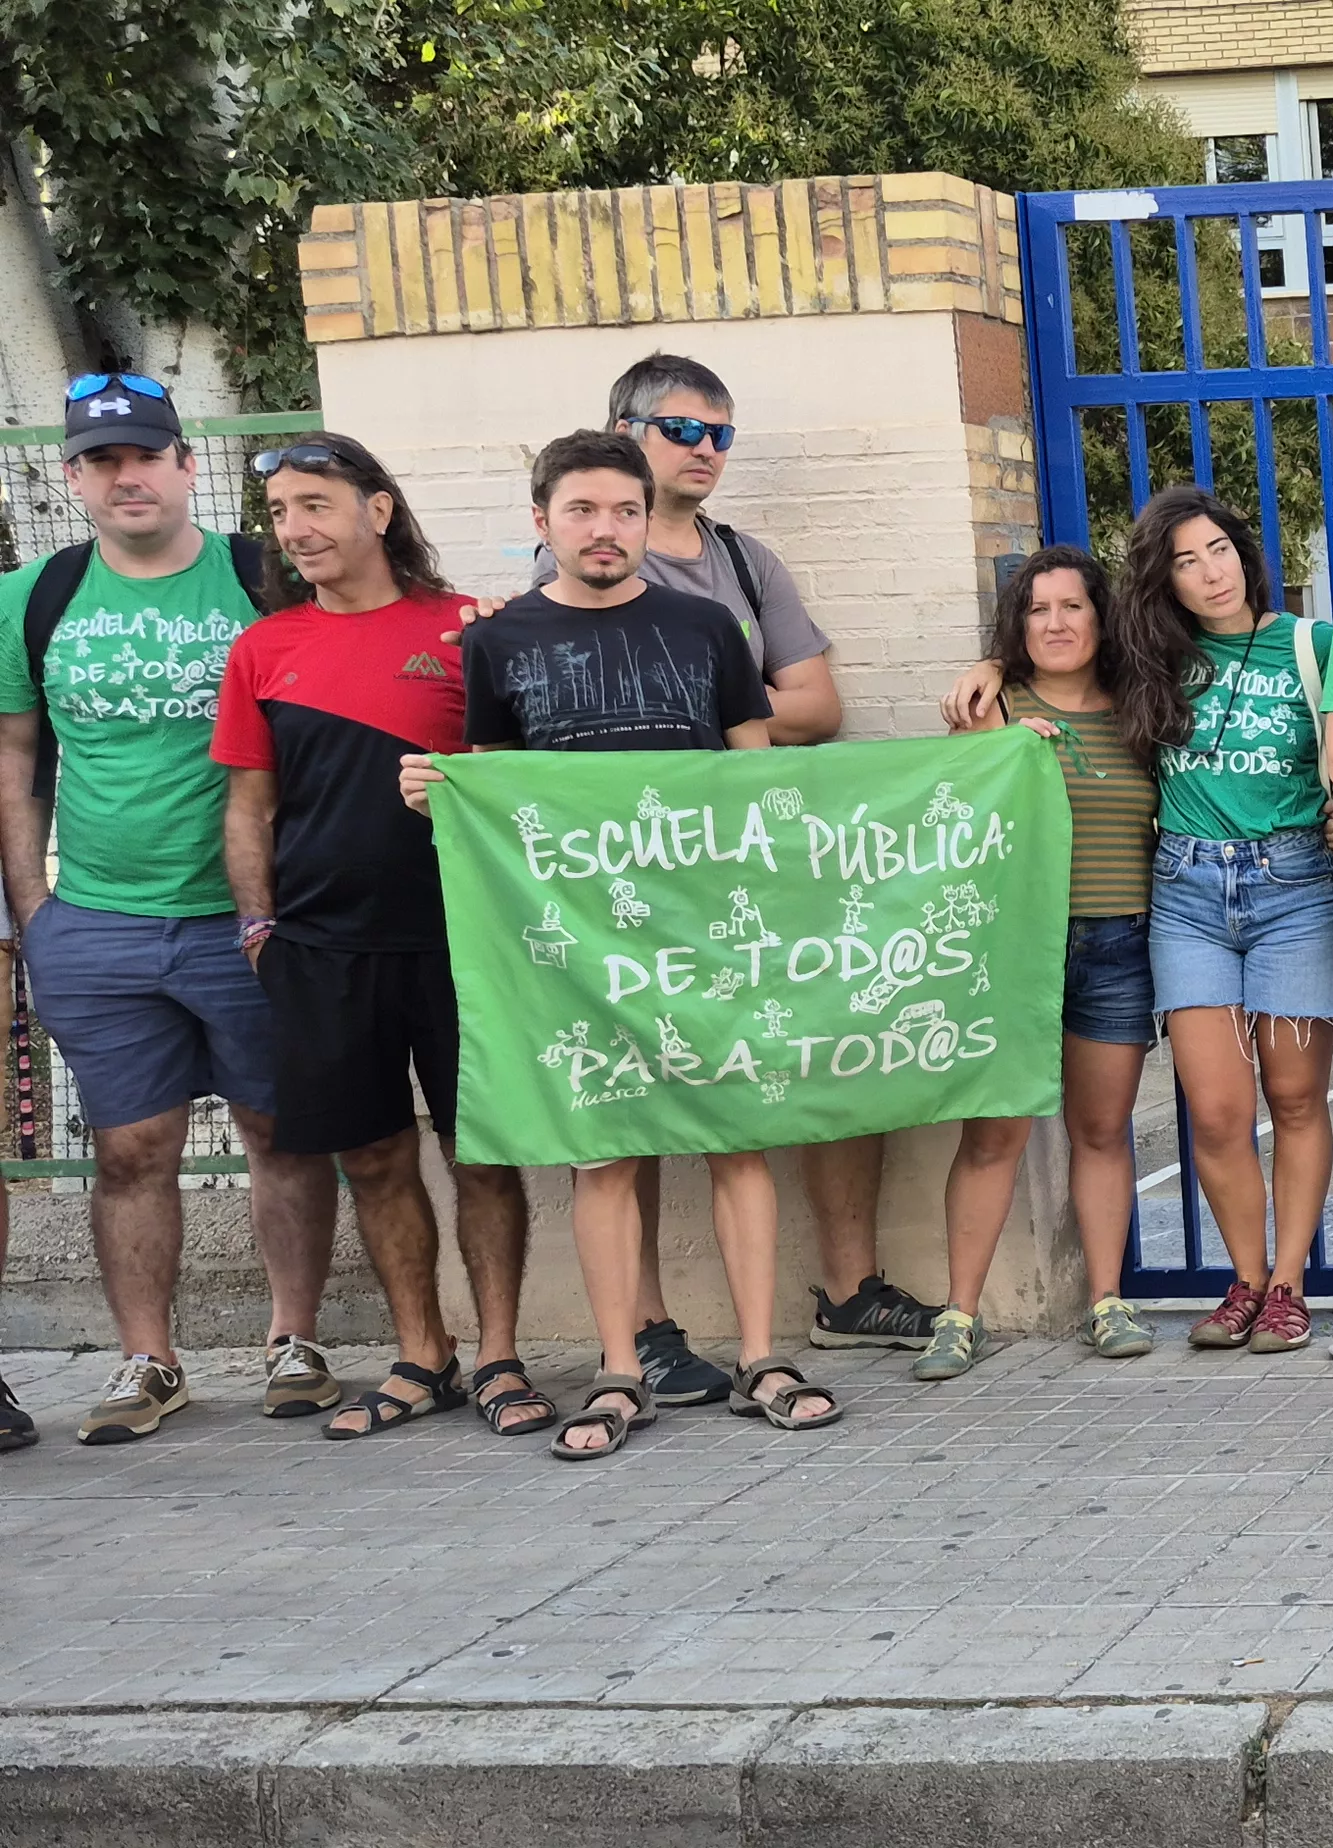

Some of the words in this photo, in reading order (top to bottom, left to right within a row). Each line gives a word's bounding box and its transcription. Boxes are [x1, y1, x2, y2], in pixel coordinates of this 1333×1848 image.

[51, 612, 147, 643] ESCUELA
[70, 662, 106, 685] DE
[521, 802, 779, 881] ESCUELA
[801, 803, 1016, 885] PÚBLICA:
[604, 946, 697, 1004] DE
[733, 928, 974, 988] TOD@S
[563, 1039, 763, 1093] PARA
[785, 1016, 998, 1079] TOD@S
[570, 1085, 649, 1112] Huesca
